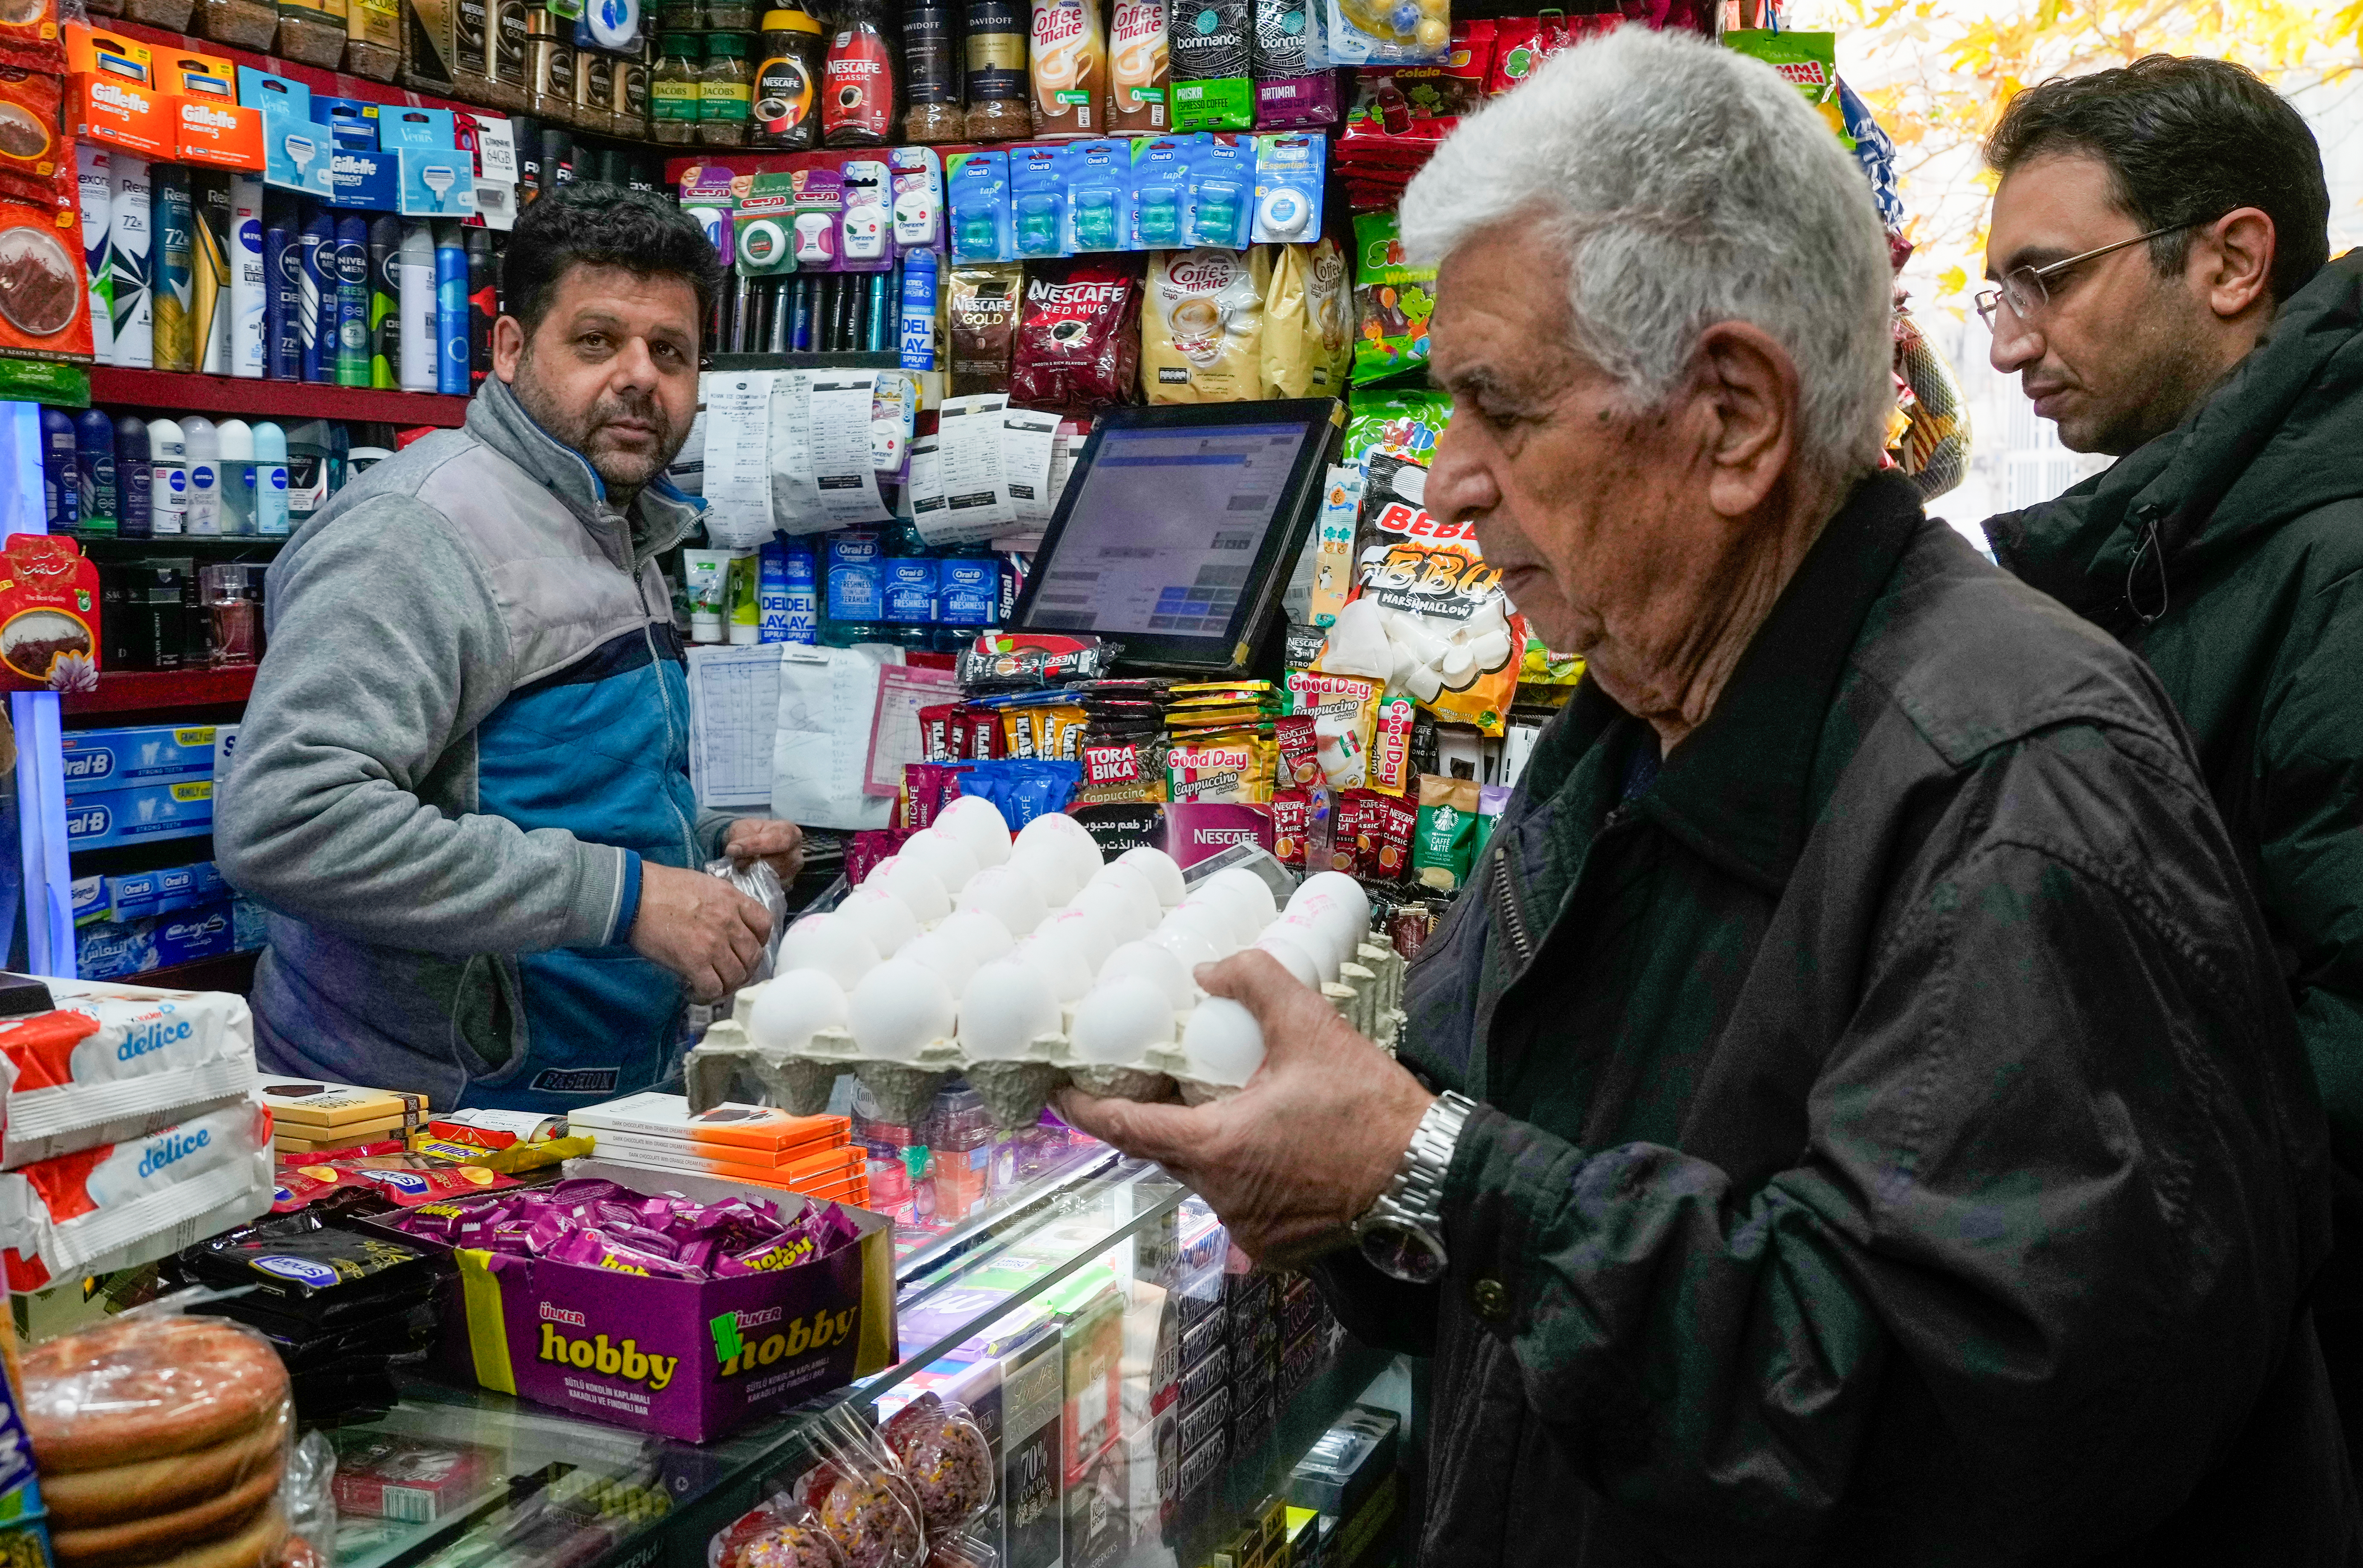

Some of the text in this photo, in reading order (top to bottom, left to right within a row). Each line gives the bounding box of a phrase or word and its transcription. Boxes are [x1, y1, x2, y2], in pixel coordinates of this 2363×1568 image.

[969, 16, 1013, 26] DAVIDOFF
[1033, 5, 1082, 33] Coffee
[1112, 3, 1163, 32] Coffee
[1040, 21, 1083, 46] mate
[1119, 19, 1162, 42] mate
[1396, 67, 1441, 78] Colala
[91, 82, 150, 114] Gillette
[655, 87, 687, 95] JACOBS
[702, 87, 735, 96] JACOBS
[1177, 88, 1203, 101] PRISKA
[1262, 86, 1296, 100] ARTIMAN
[1177, 98, 1228, 110] ESPRESSO COFFEE
[182, 104, 237, 130] Gillette
[92, 124, 101, 135] 4
[185, 145, 193, 156] 4
[487, 149, 511, 164] 64GB
[1276, 150, 1307, 159] Oral-B
[332, 155, 377, 176] Gillette
[1163, 171, 1183, 182] tape
[1169, 261, 1229, 285] Coffee
[1186, 276, 1229, 293] mate
[1042, 302, 1108, 314] RED MUG
[962, 313, 1004, 325] GOLD
[903, 320, 930, 334] DEL
[903, 356, 927, 364] SPRAY
[839, 543, 872, 555] Oral-B
[899, 569, 923, 577] Oral-B
[955, 571, 979, 579] Oral-B
[894, 599, 929, 608] FRESHNESS
[1000, 575, 1013, 620] Signal
[949, 601, 985, 610] FRESHNESS
[1382, 593, 1470, 617] MARSHMALLOW
[788, 631, 811, 639] SPRAY
[1287, 675, 1372, 701] Good Day
[1293, 700, 1358, 719] Cappuccino
[1378, 700, 1411, 787] Good Day
[1087, 747, 1134, 765] TORA
[1286, 746, 1316, 758] CLASSIC
[1167, 749, 1249, 772] Good Day
[1093, 764, 1134, 781] BIKA
[1174, 771, 1237, 797] Cappuccino
[1083, 788, 1146, 803] Cappuccino
[1118, 819, 1140, 833] طعم
[1142, 819, 1152, 833] از
[1383, 833, 1408, 846] CLASSIC
[1430, 844, 1449, 852] LATTE
[545, 1071, 613, 1092] FASHION
[293, 1095, 339, 1106] DARK
[317, 1099, 366, 1110] 60%
[609, 1095, 675, 1113] GALLARDO
[623, 1121, 644, 1130] CHOCOLATE
[654, 1125, 669, 1133] ORANGE
[623, 1136, 645, 1144] CHOCOLATE
[639, 1153, 661, 1161] CHOCOLATE
[540, 1301, 586, 1327] ÜLKER
[721, 1306, 857, 1376] hobby
[539, 1323, 680, 1390] hobby
[565, 1377, 585, 1389] SÜTLÜ
[613, 1388, 651, 1405] KAPLAMALI
[597, 1397, 607, 1406] VE
[634, 1404, 649, 1415] BAR
[1021, 1438, 1047, 1486] 70%
[1020, 1475, 1047, 1503] COCOA
[1091, 1510, 1106, 1528] SPORT
